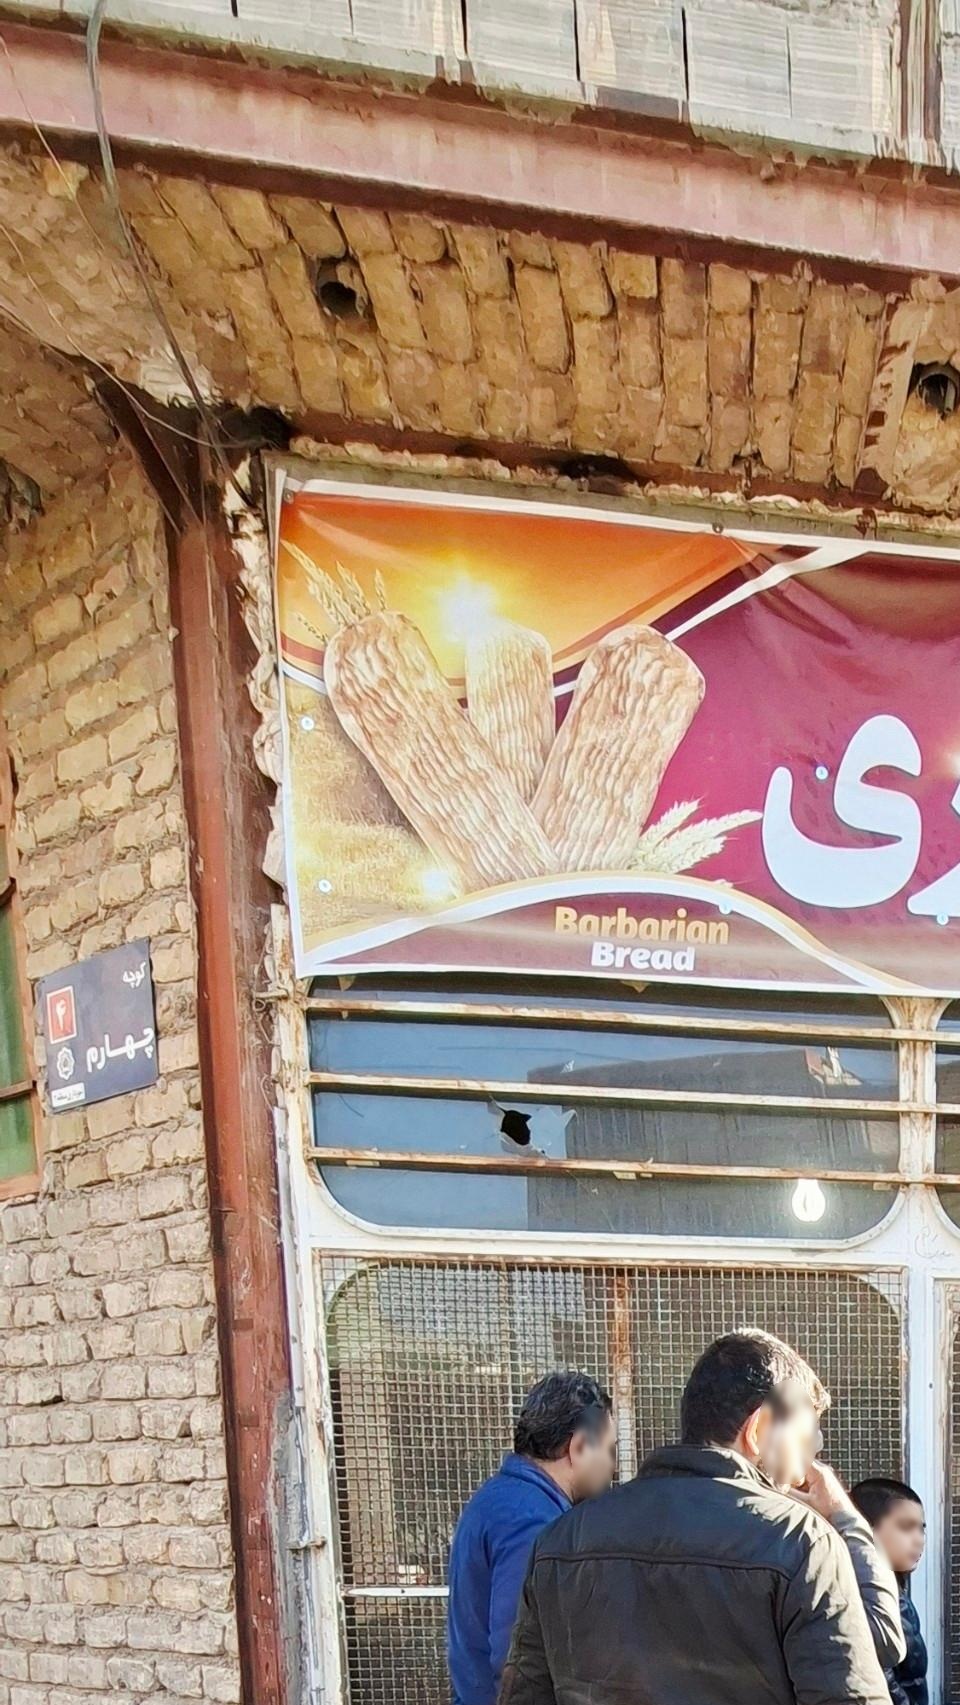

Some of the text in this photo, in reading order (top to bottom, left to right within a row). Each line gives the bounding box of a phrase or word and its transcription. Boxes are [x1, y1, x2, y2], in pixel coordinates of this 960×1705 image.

[555, 905, 729, 945] Barbarian
[591, 941, 696, 972] Bread
[122, 961, 147, 989] کوچه
[55, 999, 66, 1032] ۴
[86, 1027, 155, 1073] چهارم
